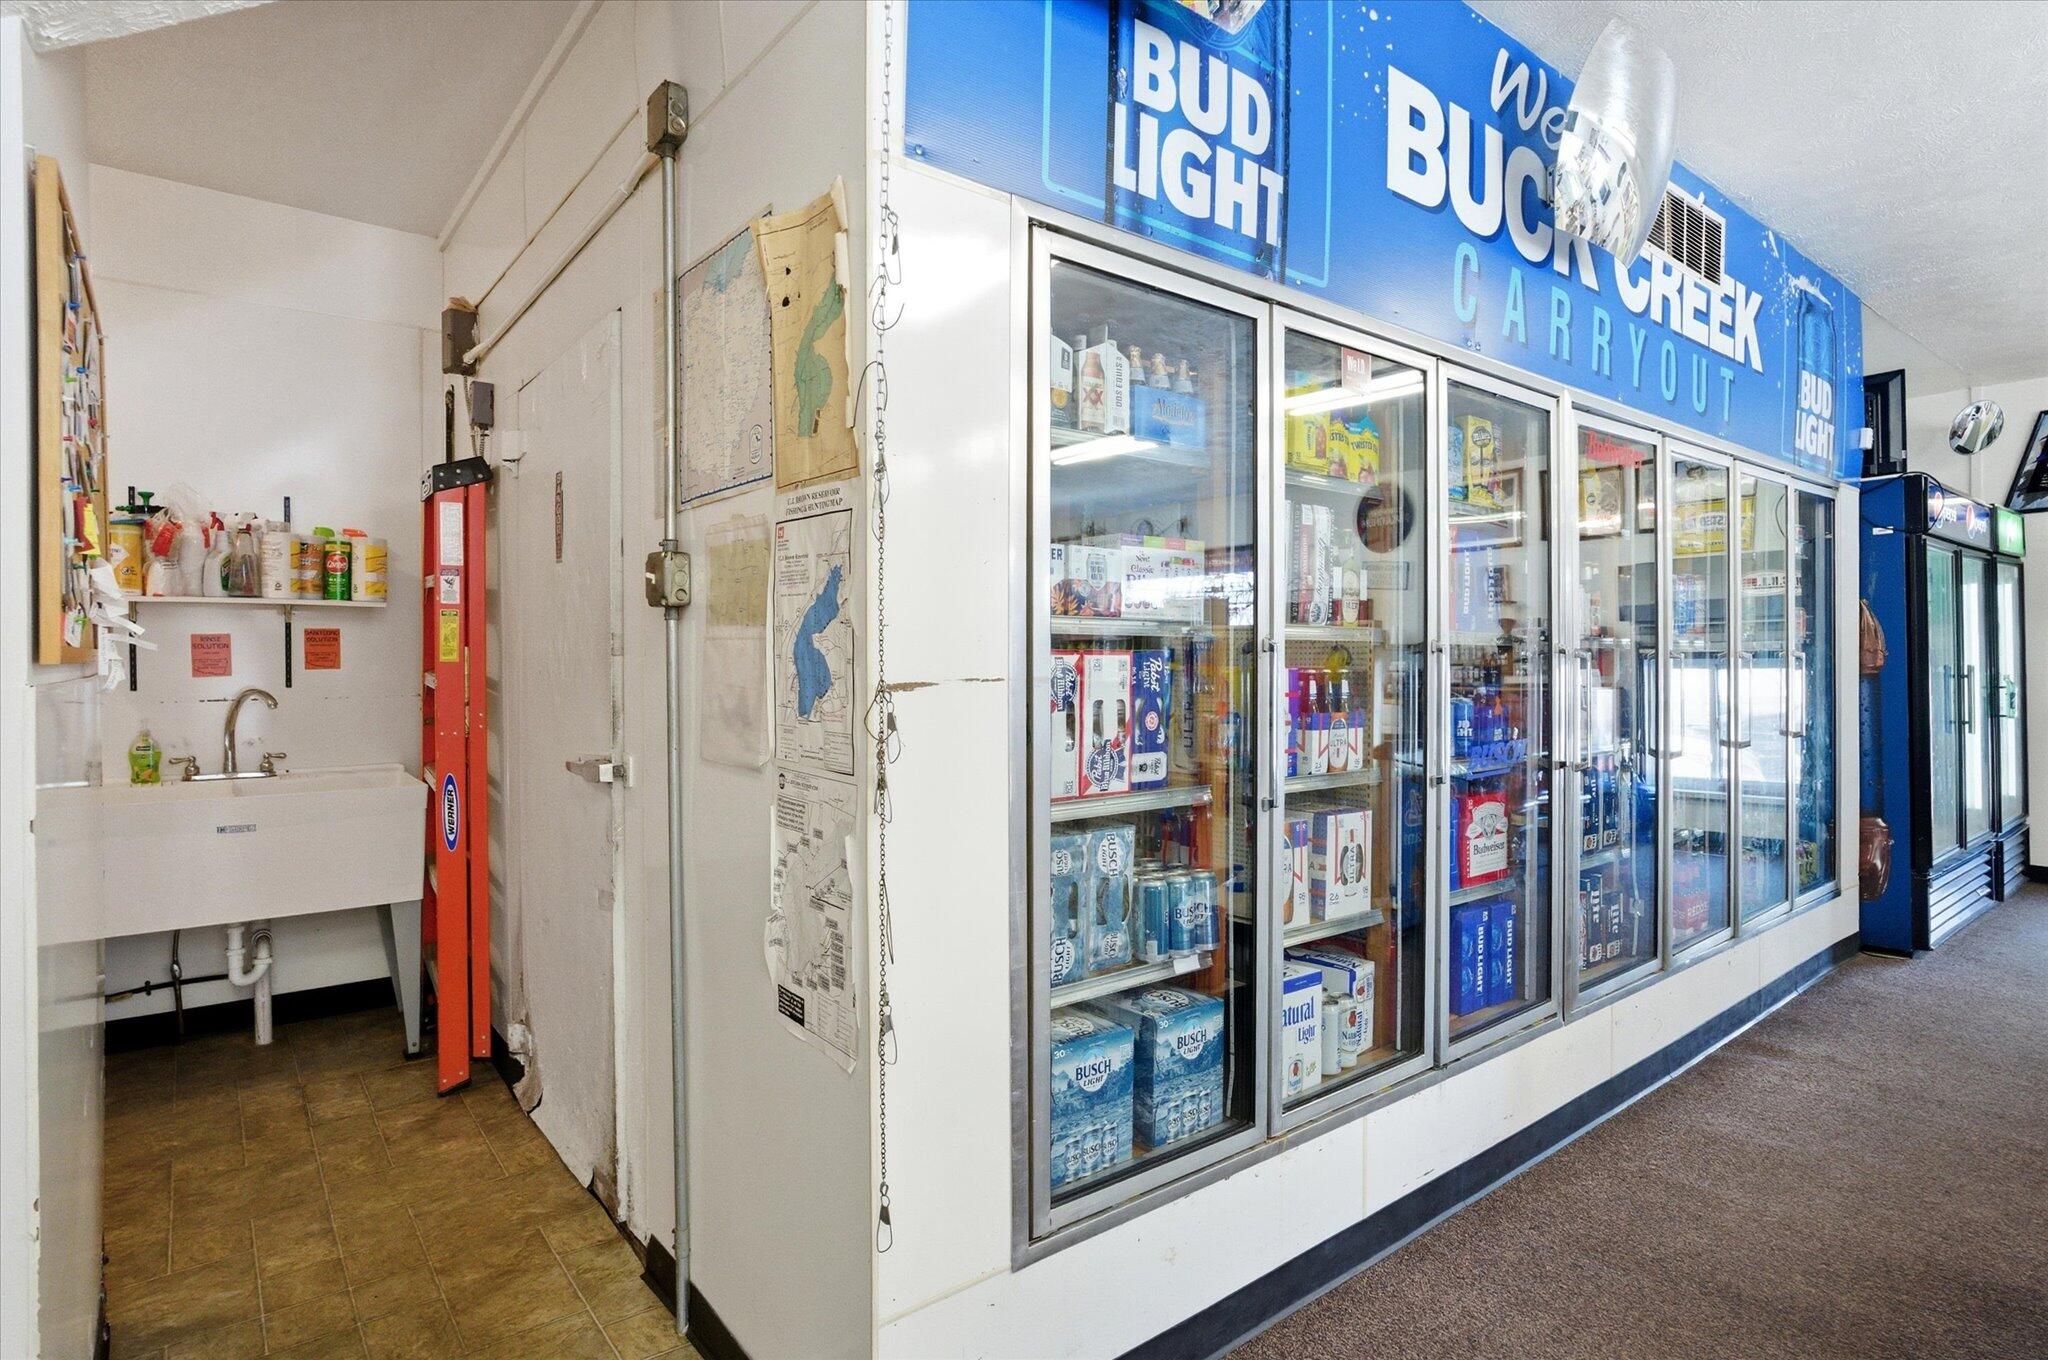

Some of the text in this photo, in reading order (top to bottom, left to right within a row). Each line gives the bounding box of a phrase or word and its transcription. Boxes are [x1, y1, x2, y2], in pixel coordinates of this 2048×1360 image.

[1133, 19, 1271, 155] BUD
[1113, 101, 1284, 248] LIGHT
[1453, 242, 1736, 424] CARRYOUT
[1115, 362, 1123, 408] DOS EQUIS
[1800, 369, 1832, 408] BUD
[1795, 408, 1835, 463] LIGHT
[192, 642, 229, 650] SOLUTION
[1149, 657, 1164, 693] Pabst
[446, 789, 456, 836] WERNER
[1106, 832, 1119, 878] BUSCH
[1348, 845, 1356, 884] ULTRA
[1473, 841, 1506, 856] Budweiser
[1052, 936, 1067, 983] BUSCH
[1159, 1020, 1169, 1029] 30
[1176, 1029, 1208, 1050] BUSCH
[1298, 1023, 1317, 1044] Light
[1054, 1050, 1066, 1060] 30
[1183, 1044, 1202, 1055] LIGHT
[1075, 1059, 1112, 1081] BUSCH
[1083, 1075, 1105, 1087] LIGHT
